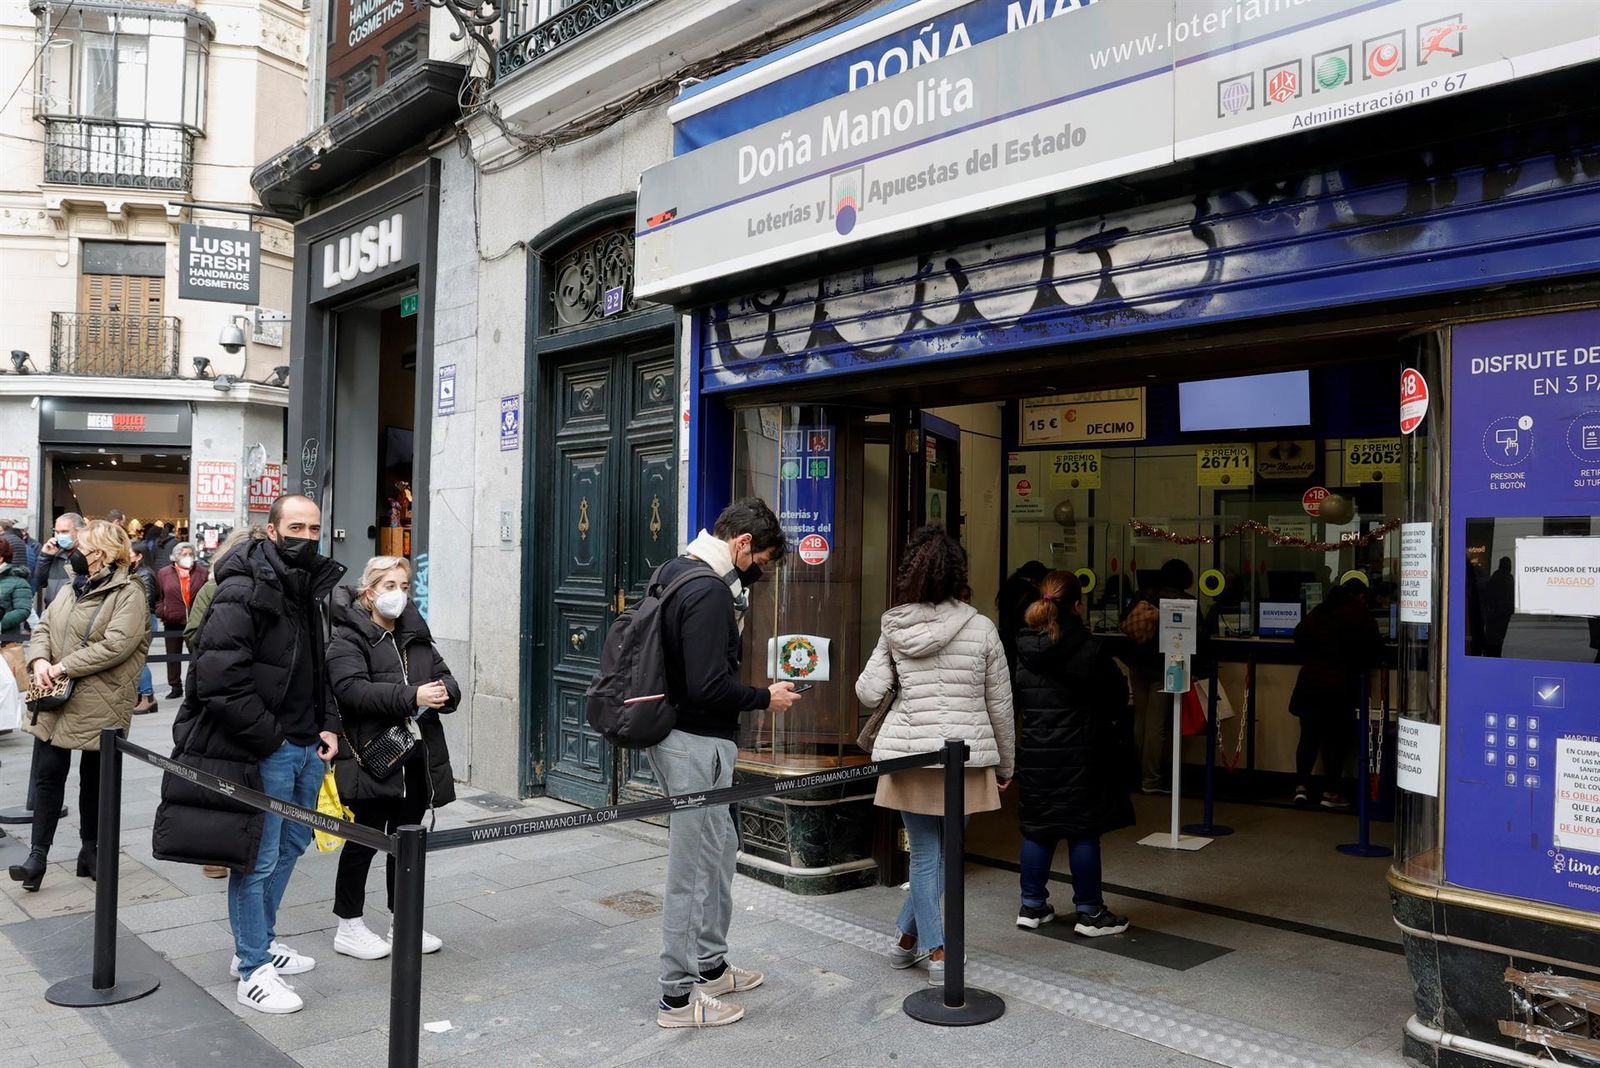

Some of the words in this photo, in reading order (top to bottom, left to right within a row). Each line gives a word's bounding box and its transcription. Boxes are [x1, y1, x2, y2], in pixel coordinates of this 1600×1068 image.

[349, 0, 404, 48] COSMETICS
[1292, 90, 1413, 130] Administración
[1444, 73, 1467, 92] 67
[738, 129, 812, 185] Doña
[820, 76, 974, 158] Manolita
[748, 198, 811, 238] Loterías
[815, 199, 826, 223] y
[868, 163, 960, 204] Apuestas
[966, 142, 998, 178] del
[1004, 122, 1087, 169] Estado
[190, 236, 250, 258] LUSH
[323, 213, 402, 289] LUSH
[190, 253, 250, 273] FRESH
[189, 267, 250, 281] HANDMADE
[189, 277, 250, 291] COSMETICS
[607, 292, 619, 310] 22
[1471, 349, 1568, 375] DISFRUTE
[1533, 377, 1560, 396] EN
[1565, 375, 1579, 394] 3
[1029, 419, 1045, 431] 15
[1050, 418, 1058, 429] €
[1087, 421, 1134, 435] DECIMO
[1063, 454, 1095, 462] PREMIO
[1212, 448, 1248, 457] PREMIO
[1053, 461, 1098, 473] 70316
[1201, 456, 1249, 468] 26711
[1490, 472, 1526, 480] PRESIONE
[1500, 480, 1526, 490] BOTÓN
[197, 493, 234, 503] REBAJAS
[1309, 490, 1325, 500] +18
[813, 511, 819, 521] y
[817, 523, 831, 533] del
[806, 538, 822, 548] +18
[1524, 566, 1575, 574] DISPENSADOR
[1576, 566, 1586, 574] DE
[1546, 577, 1596, 587] APAGADO
[1508, 717, 1516, 728] 2
[1400, 725, 1419, 736] FAVOR
[1507, 735, 1516, 746] 5
[1528, 756, 1537, 768] 9
[774, 764, 879, 792] WWW.LOTERIAMANOLITA.COM
[1564, 772, 1580, 780] PARA
[1574, 782, 1586, 790] DEL
[1560, 790, 1571, 799] ES
[1573, 792, 1600, 802] OBLIG
[1572, 803, 1589, 812] QUE
[269, 801, 340, 832] WWW.LOTERIAMANOLITA.COM
[1574, 814, 1583, 822] SE
[471, 809, 619, 841] WWW.LOTERIAMANOLITA.COM
[1560, 823, 1571, 832] DE
[1573, 825, 1594, 835] UNO
